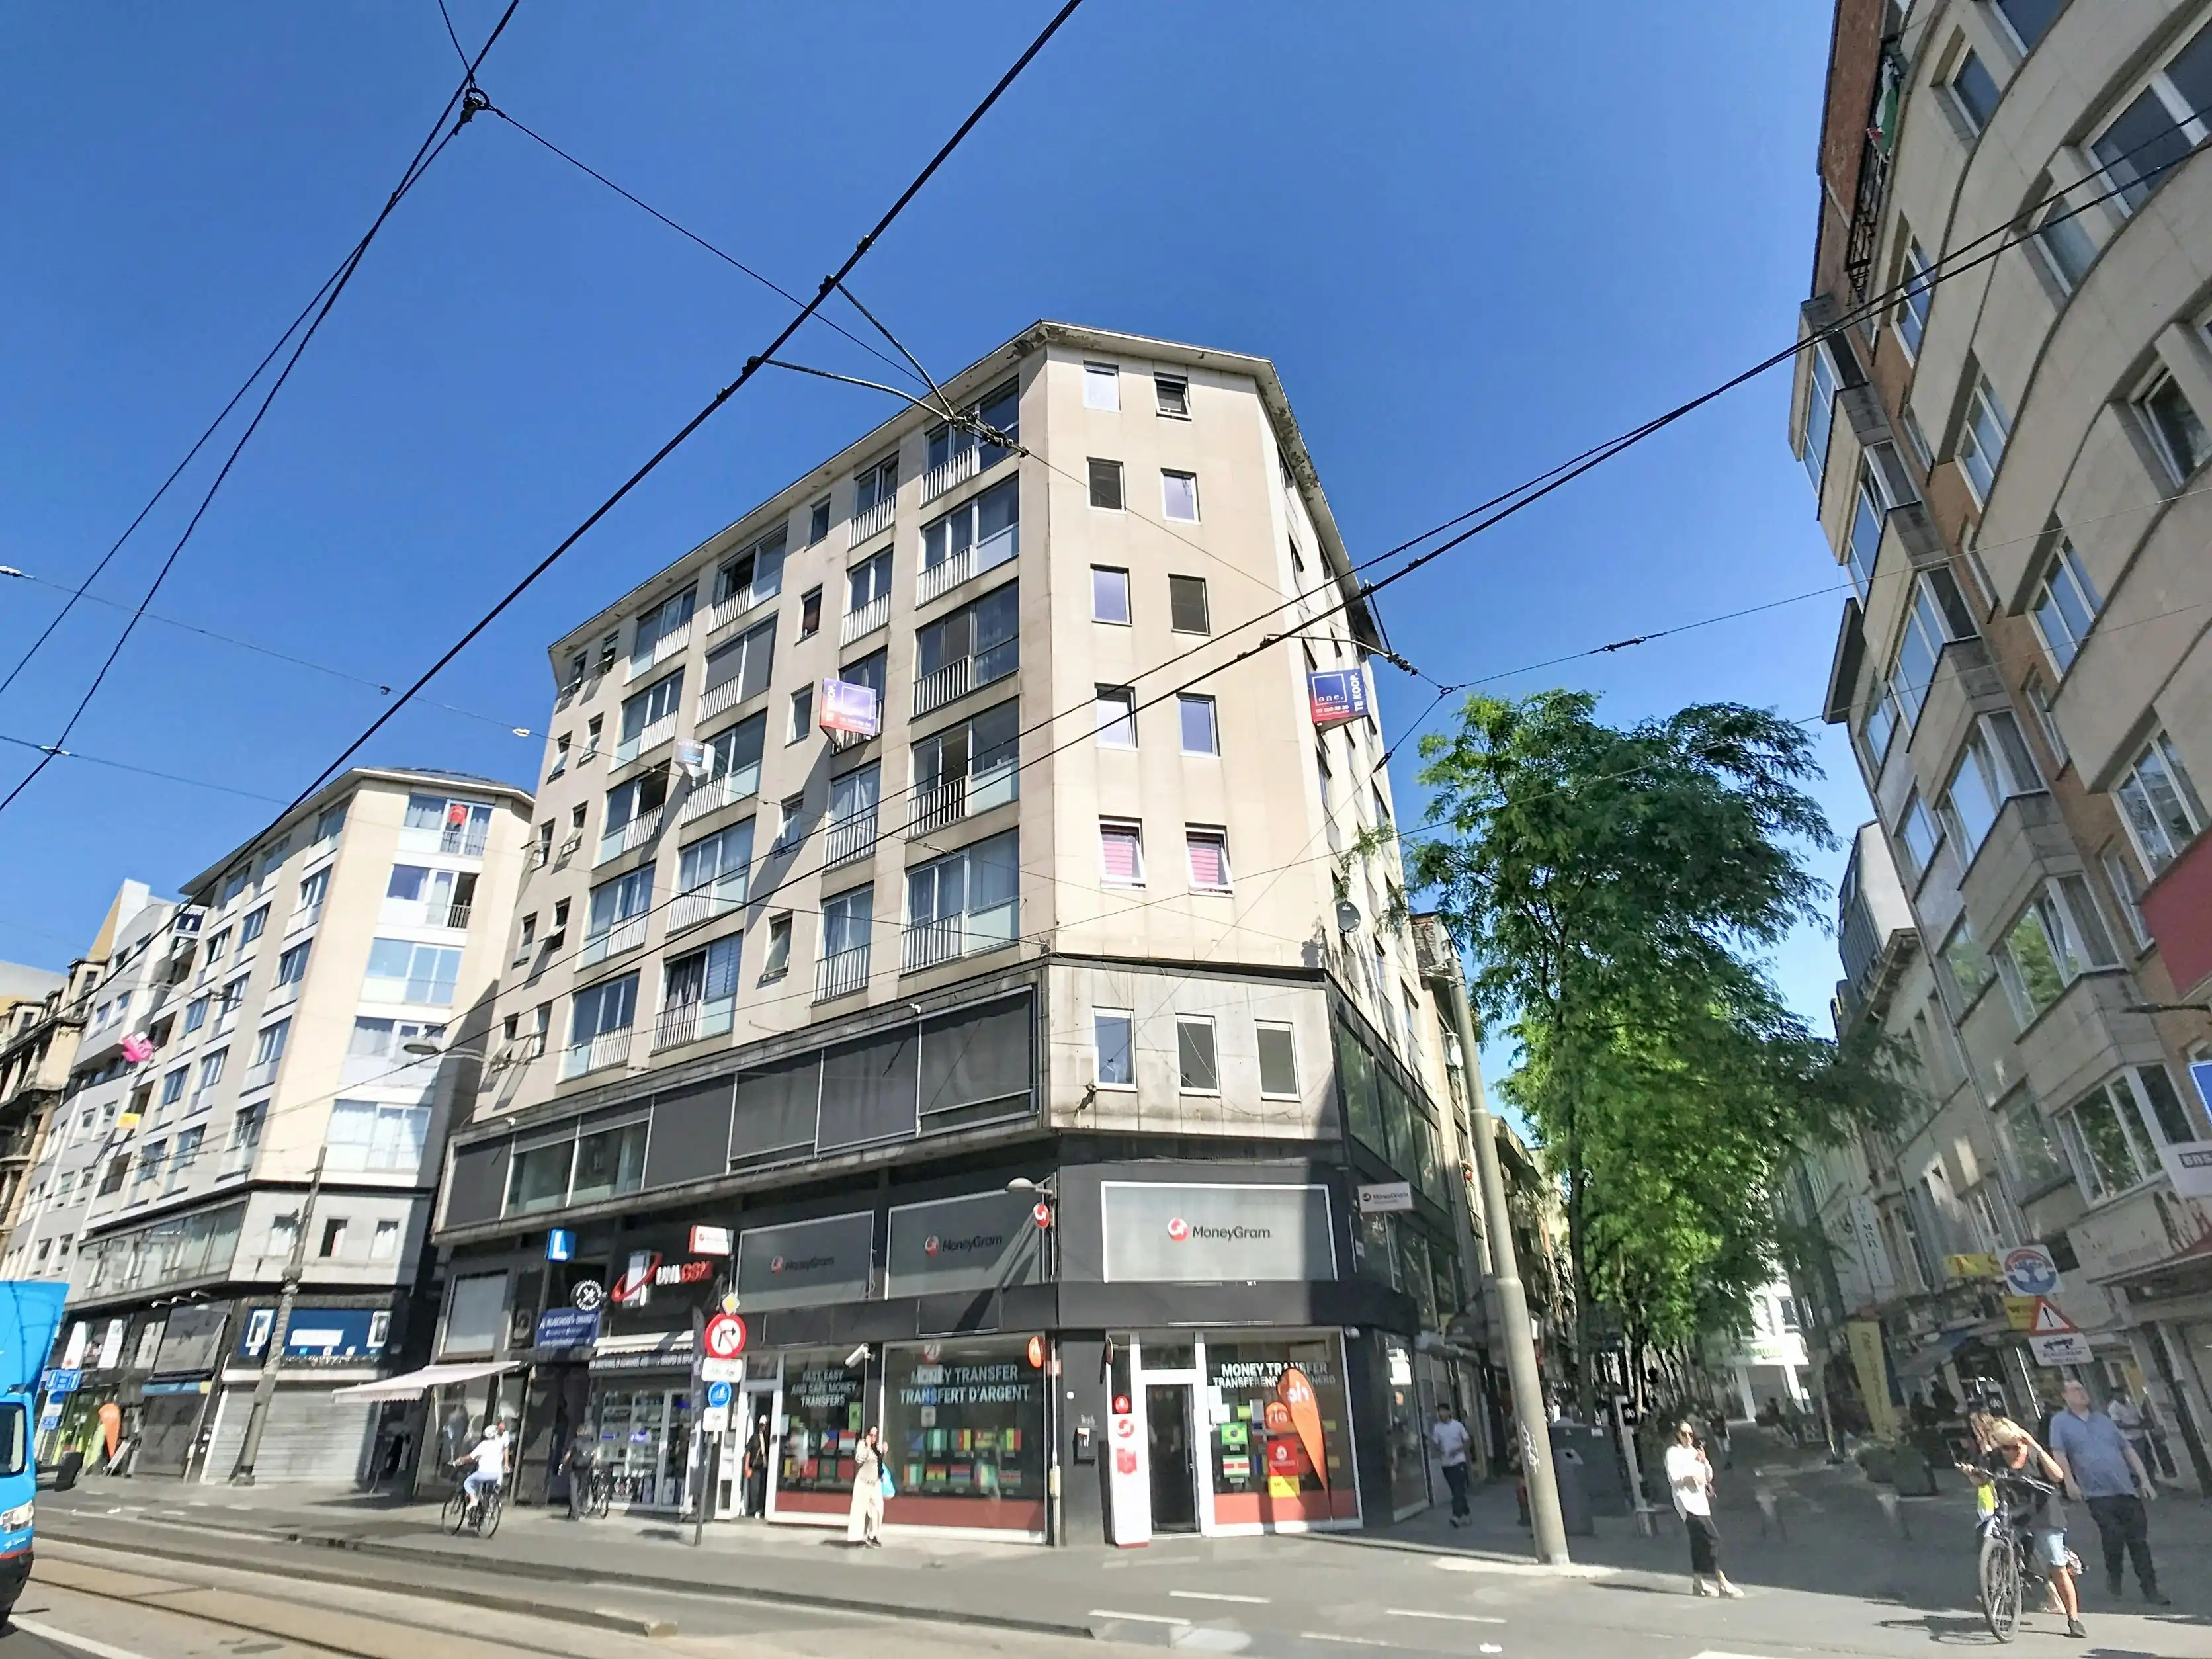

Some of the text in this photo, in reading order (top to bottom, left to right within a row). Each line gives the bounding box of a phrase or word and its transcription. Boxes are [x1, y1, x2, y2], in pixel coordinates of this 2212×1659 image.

[1353, 701, 1364, 712] TE
[941, 1234, 1003, 1252] MoneyGram
[1193, 1225, 1271, 1243] MoneyGram
[552, 1230, 567, 1260] L
[910, 1365, 1018, 1384] MONEY TRANSFER
[1221, 1363, 1264, 1377] MONEY
[800, 1394, 845, 1408] TRANSFERS
[899, 1384, 1031, 1405] TRANSFERT D'ARGENT
